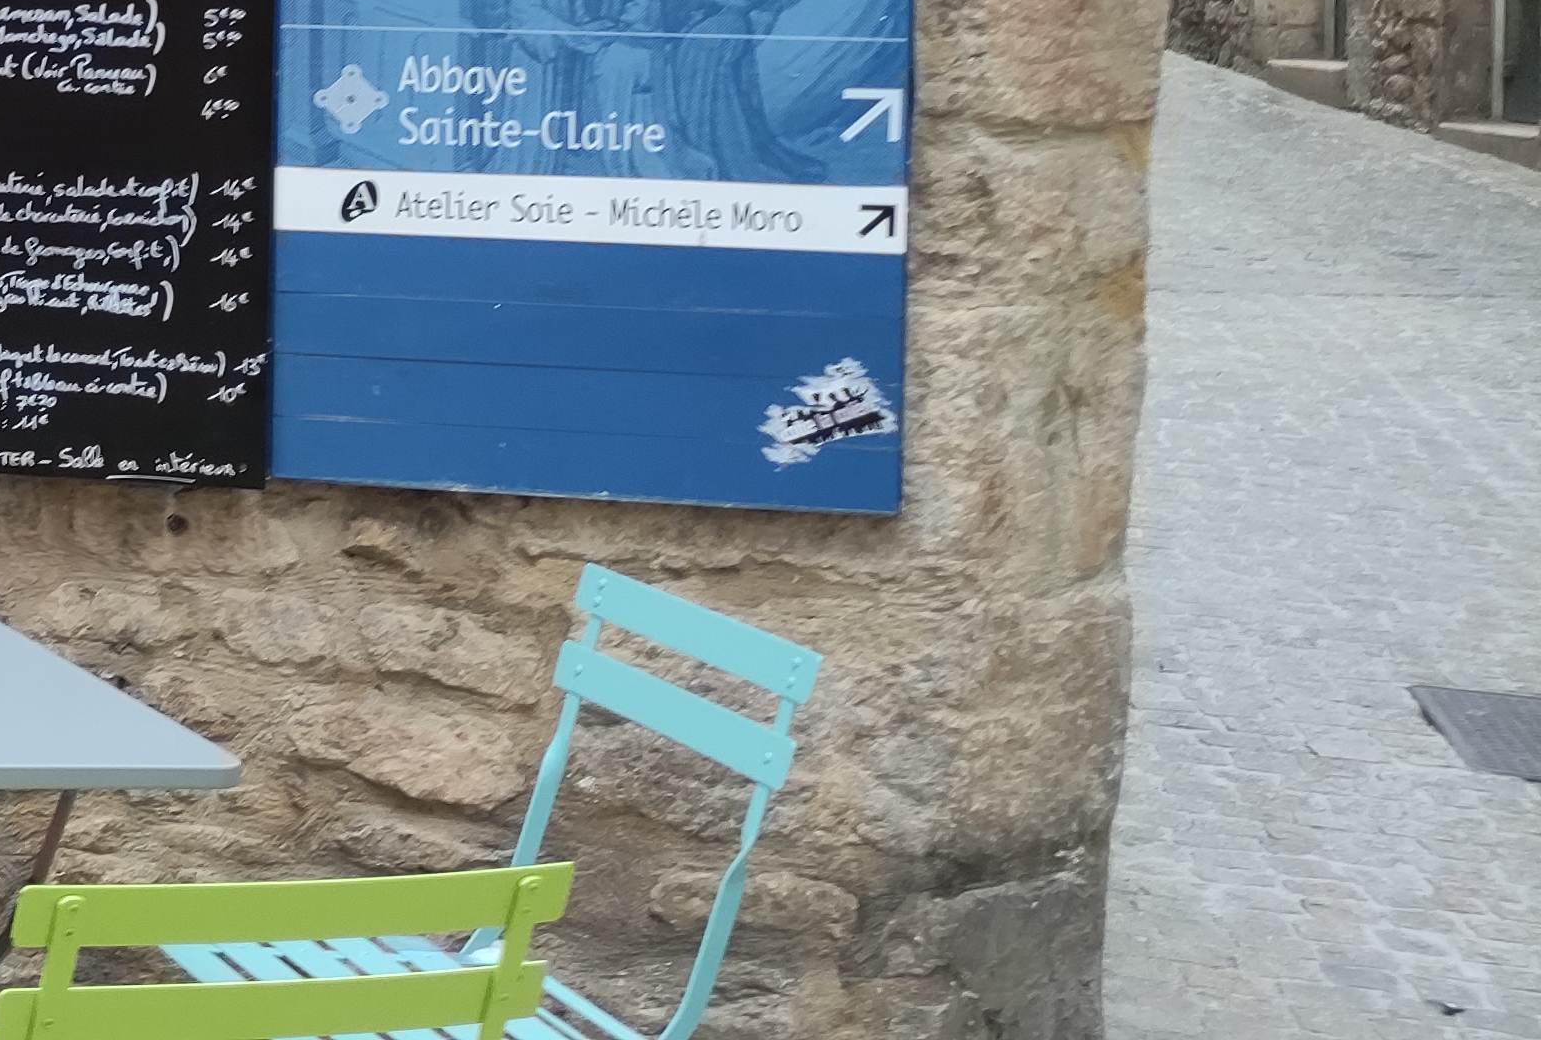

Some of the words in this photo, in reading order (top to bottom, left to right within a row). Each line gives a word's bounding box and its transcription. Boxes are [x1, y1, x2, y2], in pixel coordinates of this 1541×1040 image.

[397, 55, 529, 105] Abbaye
[397, 106, 666, 153] Sainte-Claire
[394, 189, 500, 225] Atelier
[509, 194, 575, 227] Soie
[608, 198, 722, 233] Michèle
[730, 203, 804, 233] Moro
[58, 444, 105, 468] Salle
